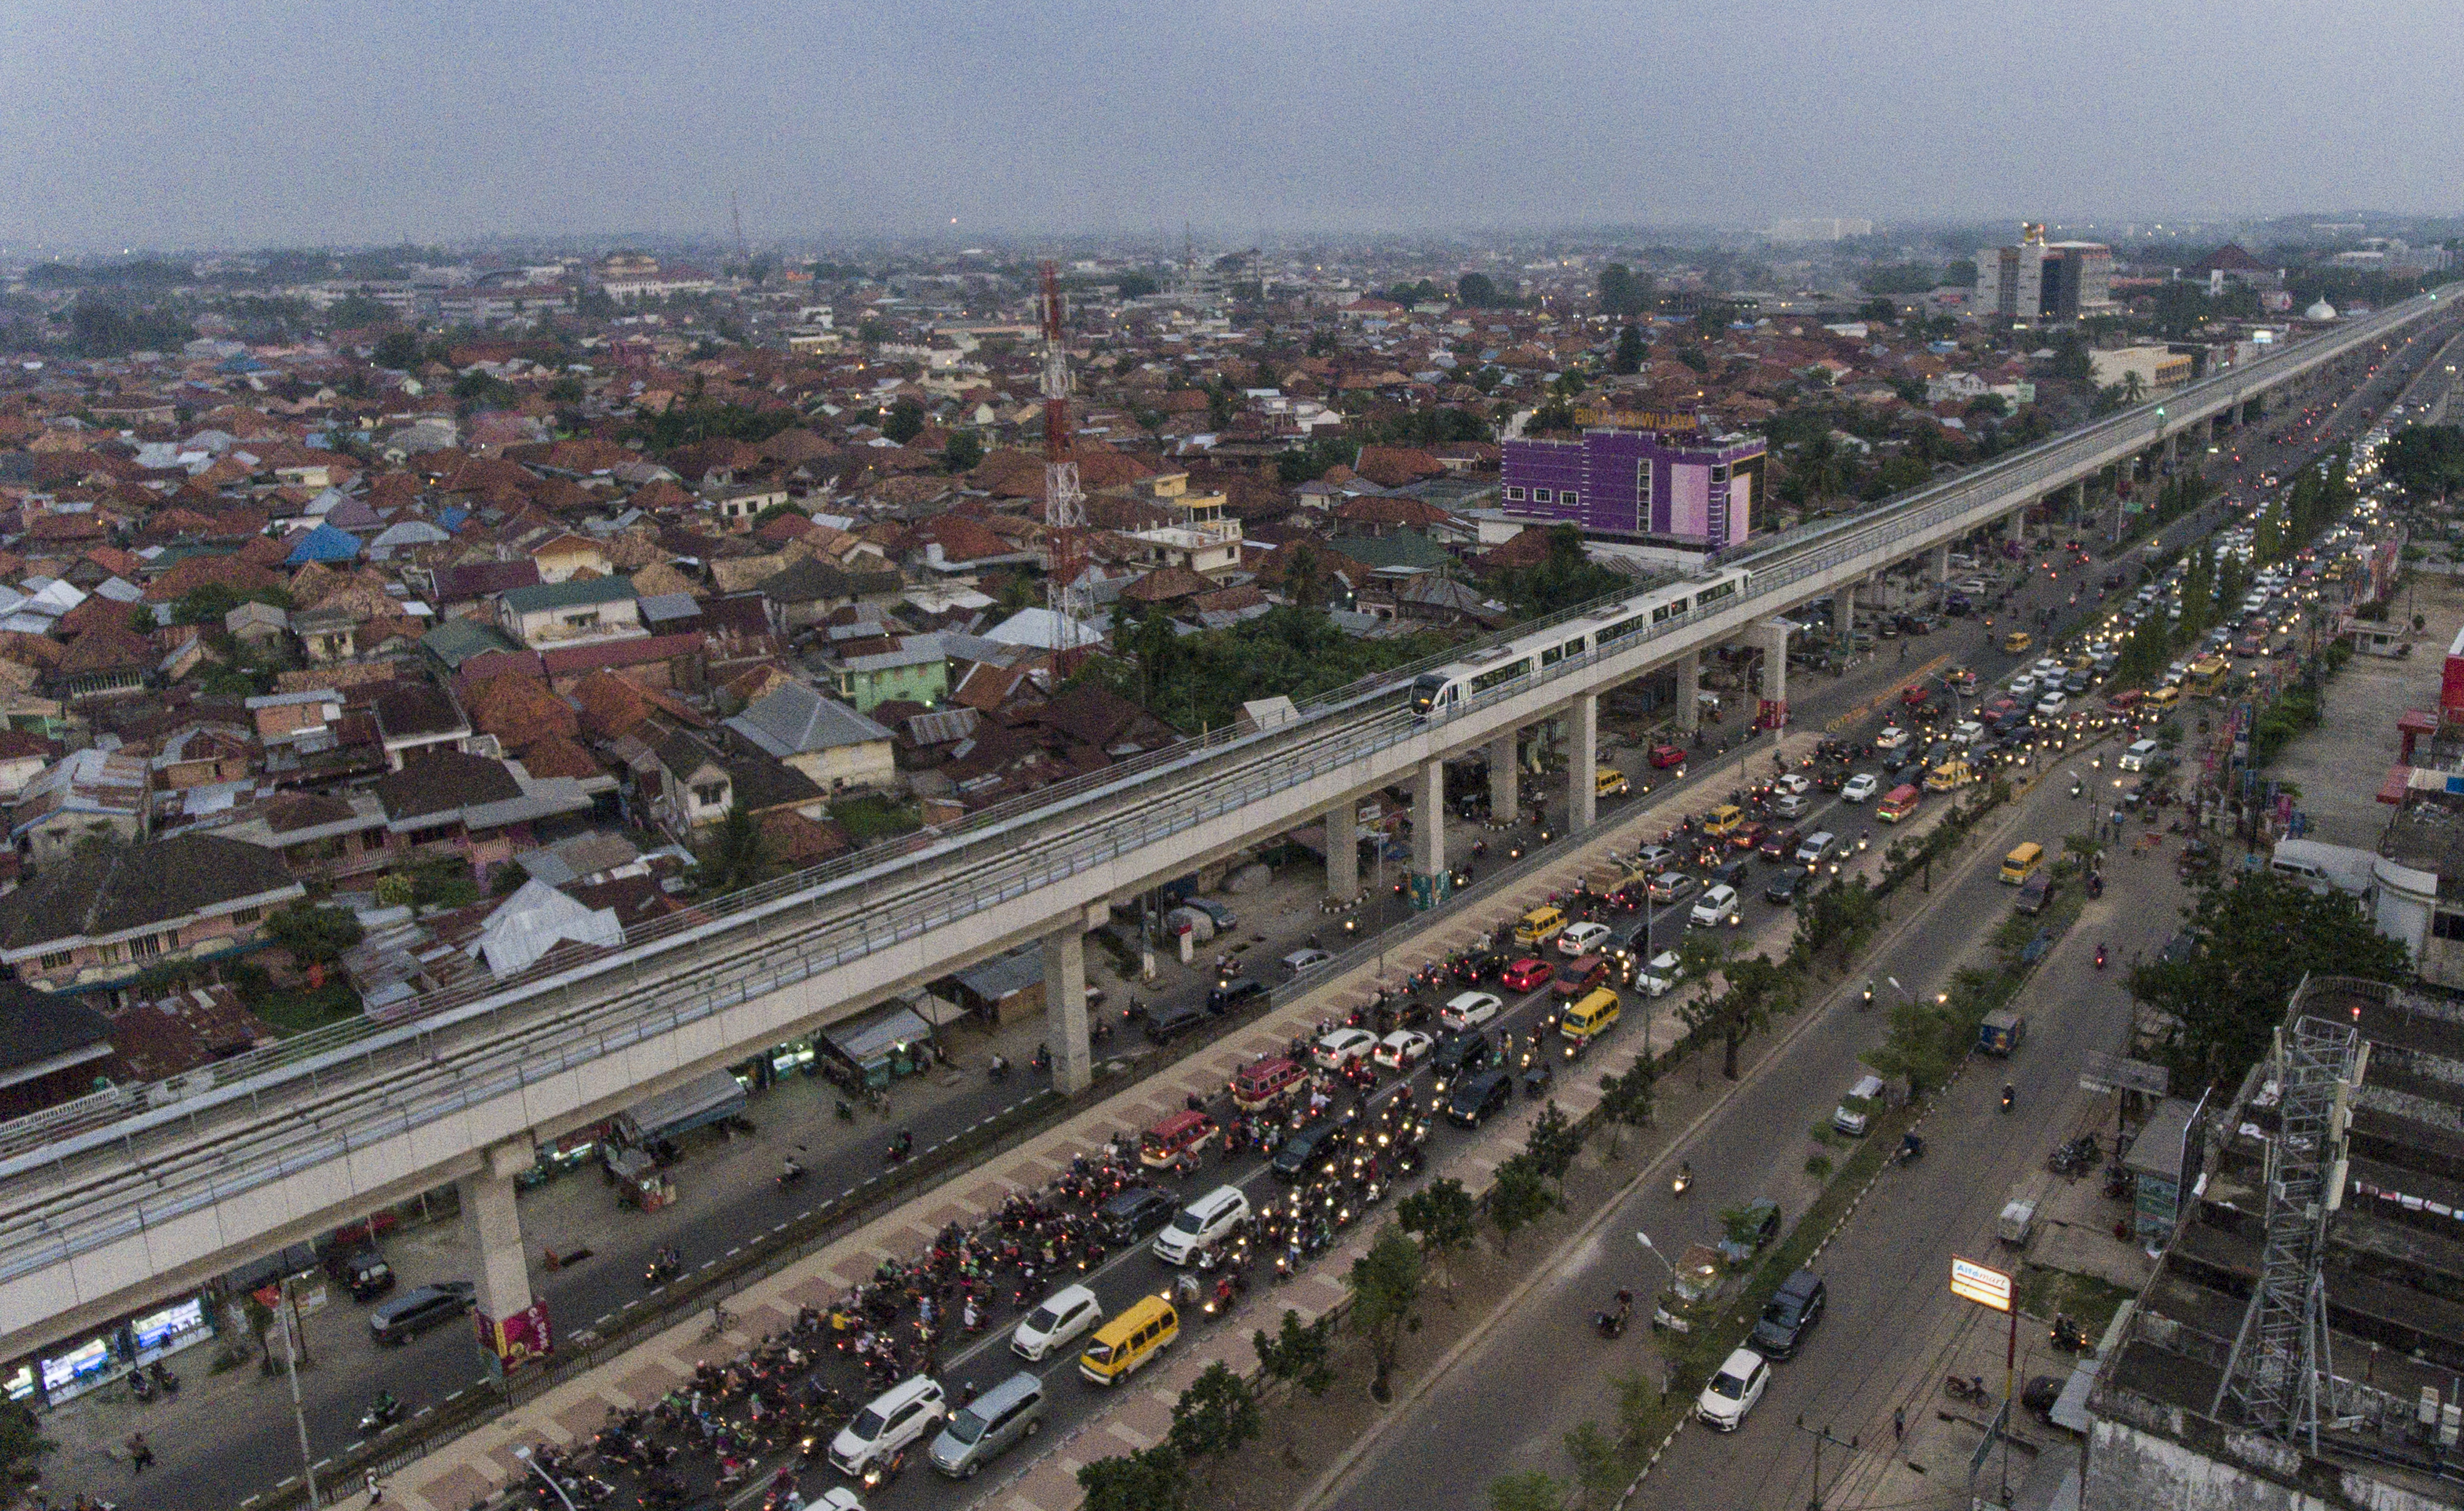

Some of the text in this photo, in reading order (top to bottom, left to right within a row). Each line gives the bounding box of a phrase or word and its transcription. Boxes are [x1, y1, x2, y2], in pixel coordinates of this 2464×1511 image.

[1574, 408, 1696, 430] BINA SRIWIJAYA
[1957, 1264, 2005, 1286] Alfamart
